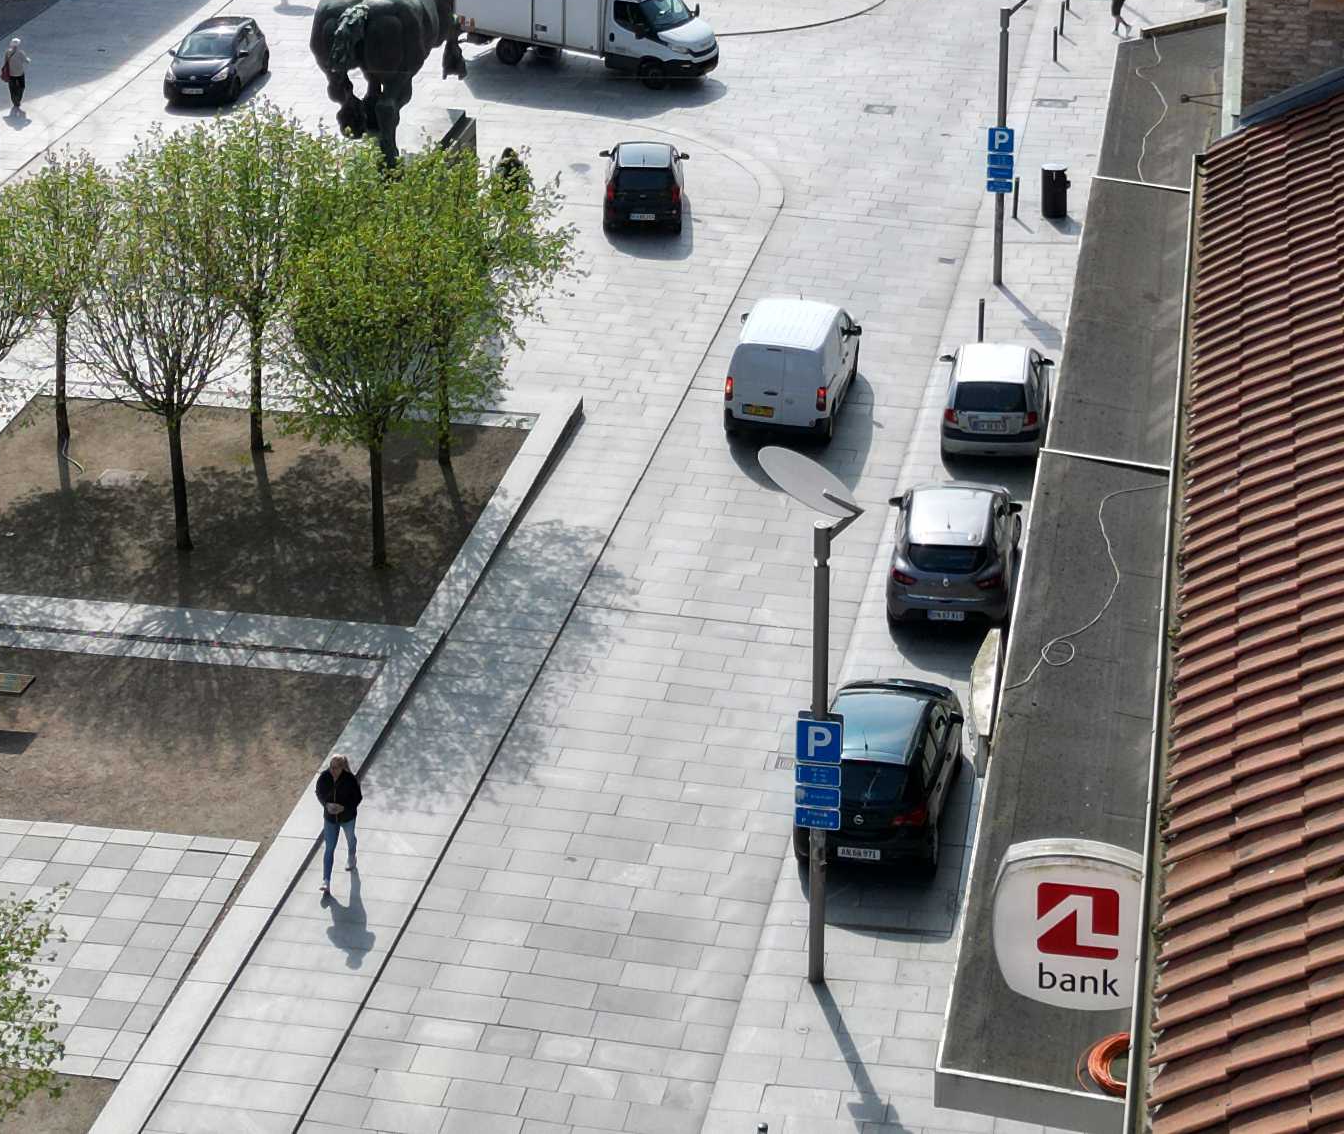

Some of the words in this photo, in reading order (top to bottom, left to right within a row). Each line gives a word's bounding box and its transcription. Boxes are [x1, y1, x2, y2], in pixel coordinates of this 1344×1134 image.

[995, 130, 1010, 150] P
[807, 726, 832, 757] P
[1038, 961, 1120, 997] bank
